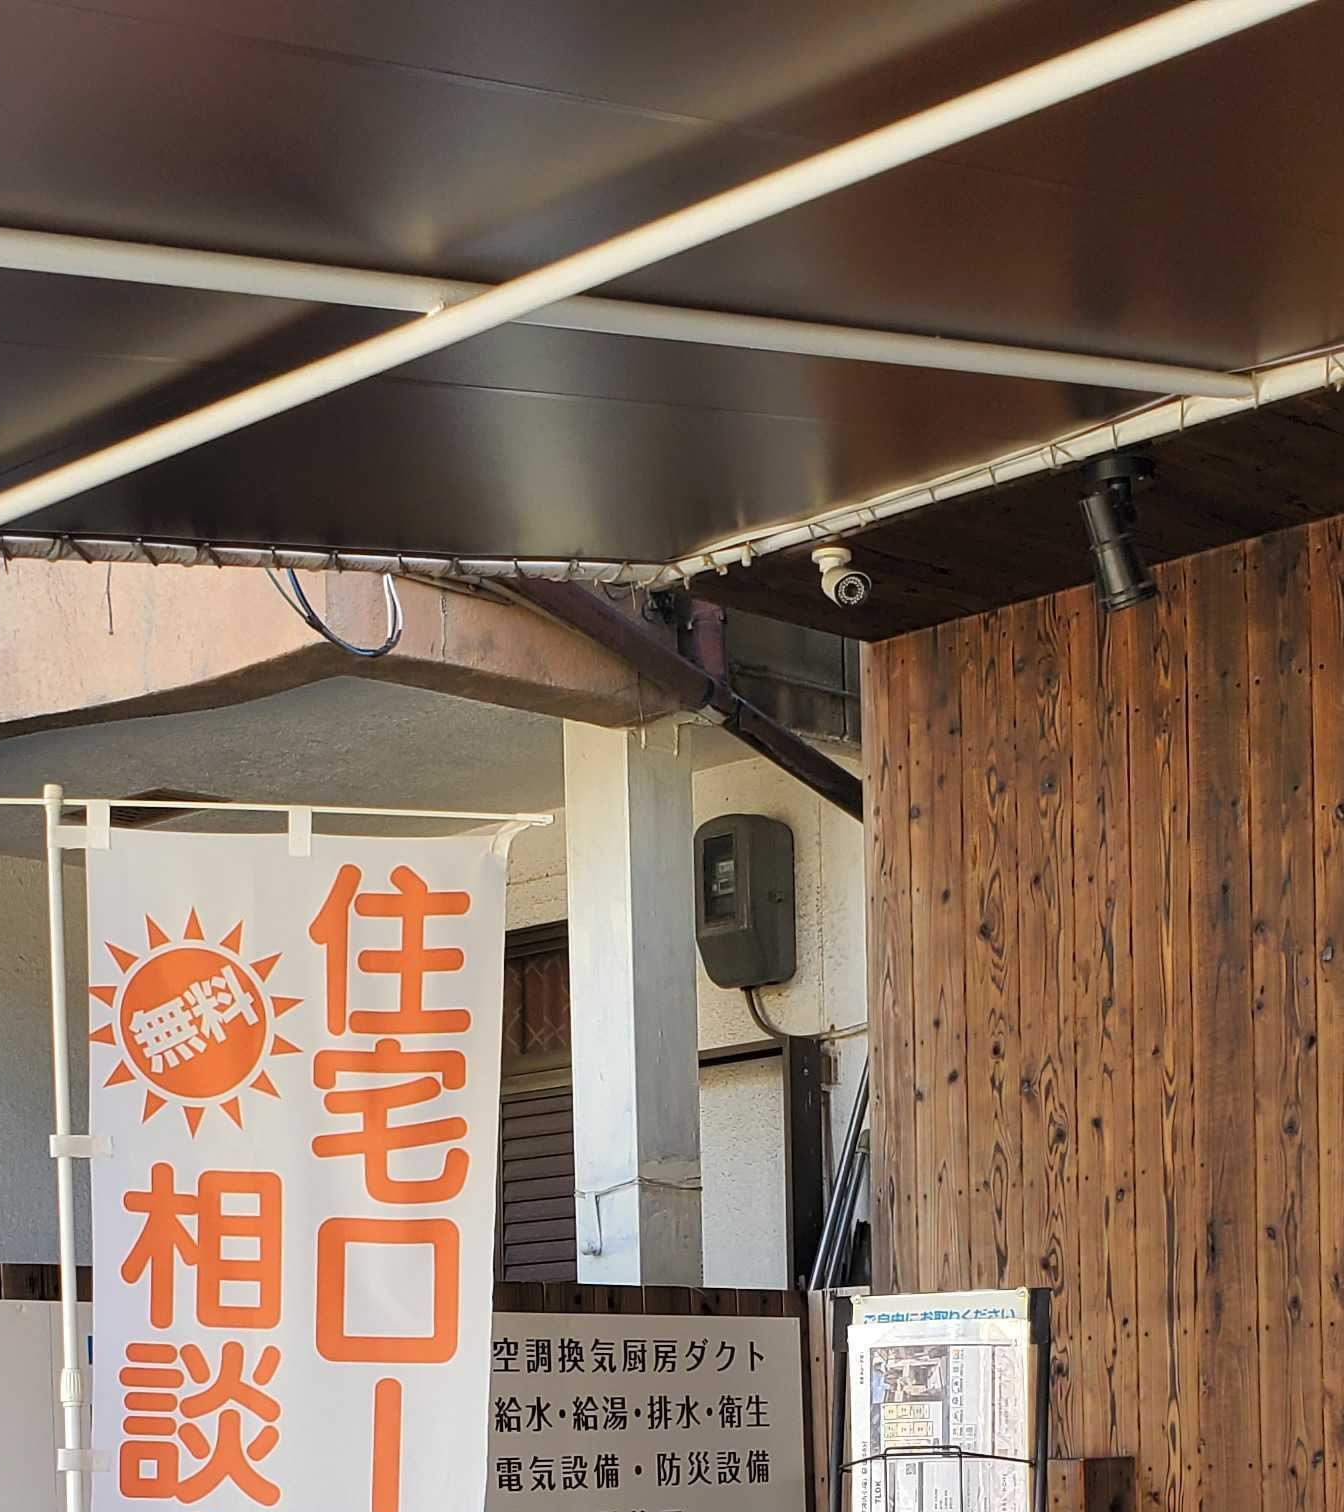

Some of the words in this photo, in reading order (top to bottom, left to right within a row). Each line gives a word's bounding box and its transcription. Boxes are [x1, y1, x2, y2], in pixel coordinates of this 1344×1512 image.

[128, 964, 261, 1074] 無料
[491, 1337, 766, 1374] 空調換気厨房ダクト
[494, 1394, 771, 1433] 給水・給湯・排水・衛生
[495, 1449, 771, 1493] 電気設備・防災設備
